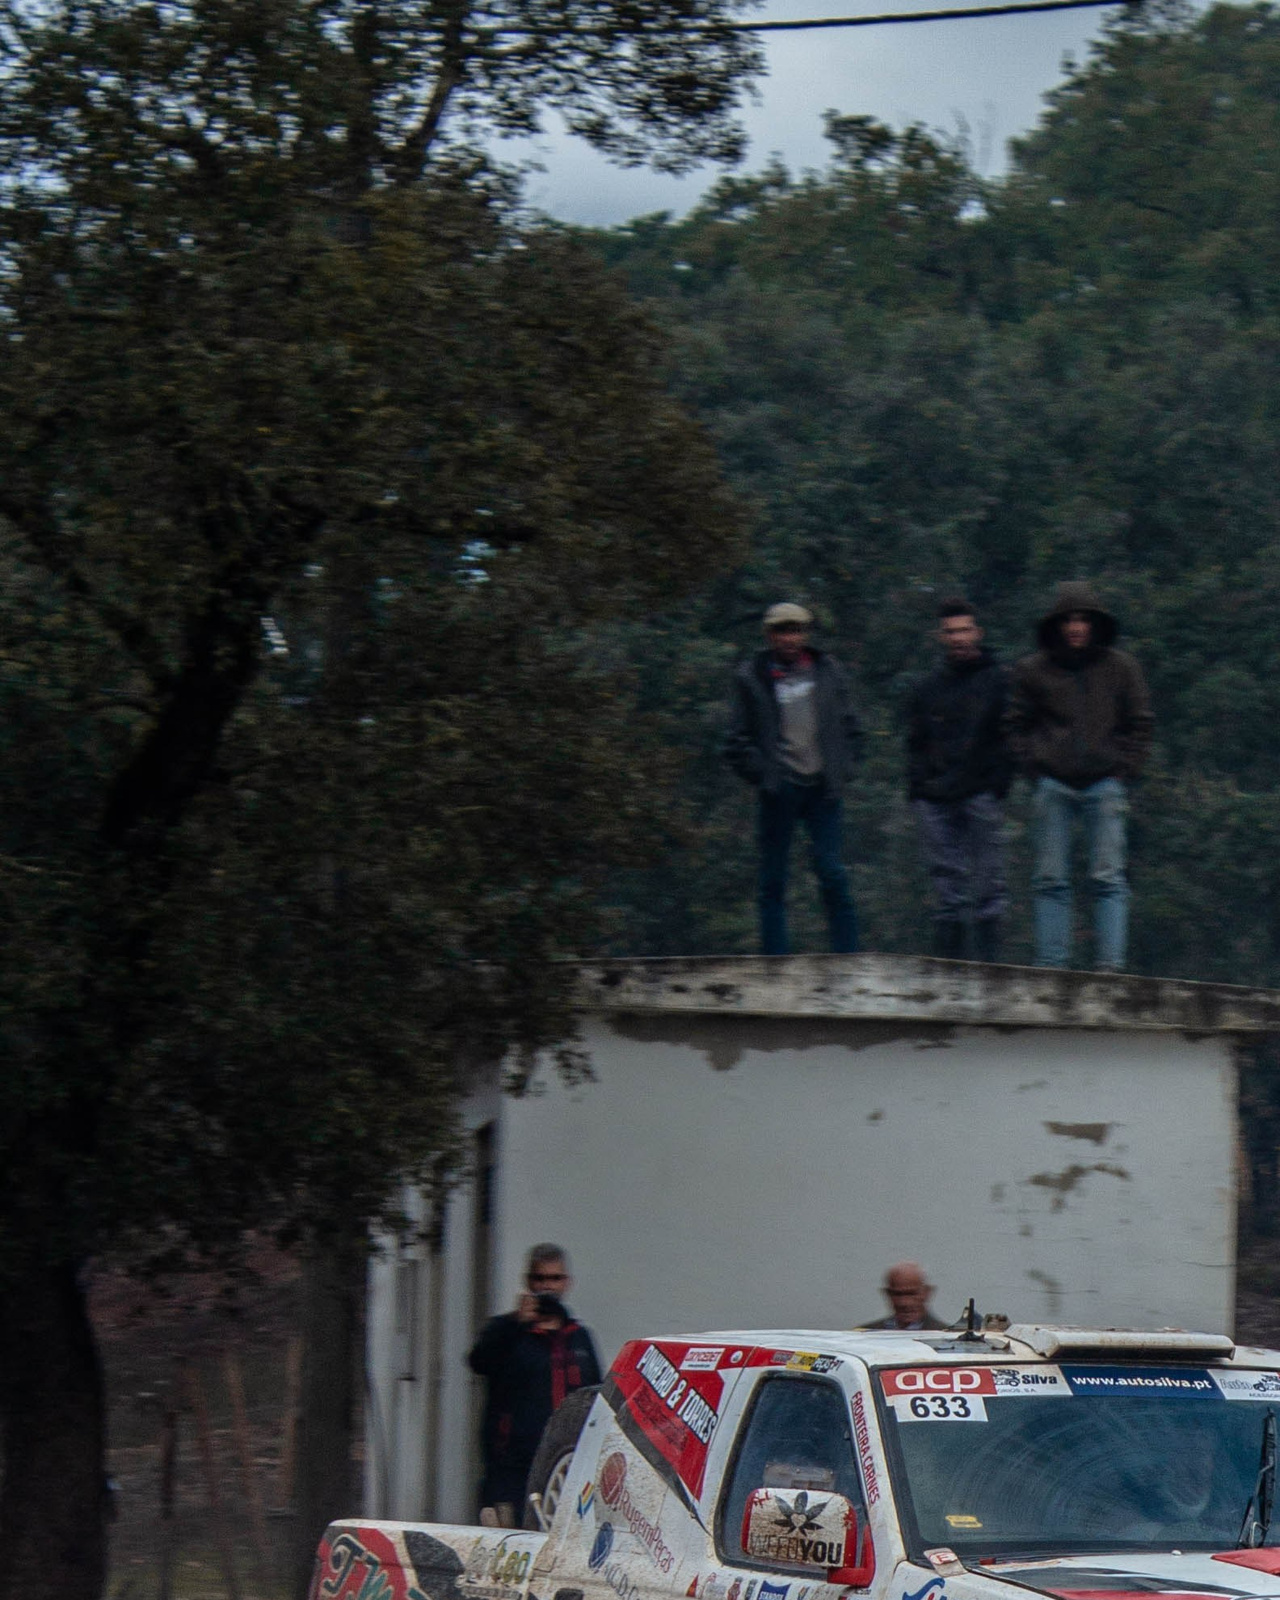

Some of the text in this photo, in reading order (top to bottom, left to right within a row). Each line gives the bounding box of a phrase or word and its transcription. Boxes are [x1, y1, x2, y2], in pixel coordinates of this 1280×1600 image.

[895, 1370, 981, 1392] acp
[1022, 1374, 1058, 1385] Silva
[1072, 1376, 1212, 1391] www.autosilva.pt
[636, 1343, 680, 1399] PINHEIRO
[666, 1379, 688, 1410] &
[677, 1387, 719, 1445] TORRES
[909, 1395, 971, 1418] 633
[852, 1391, 880, 1505] FRONTEIRA CARNES
